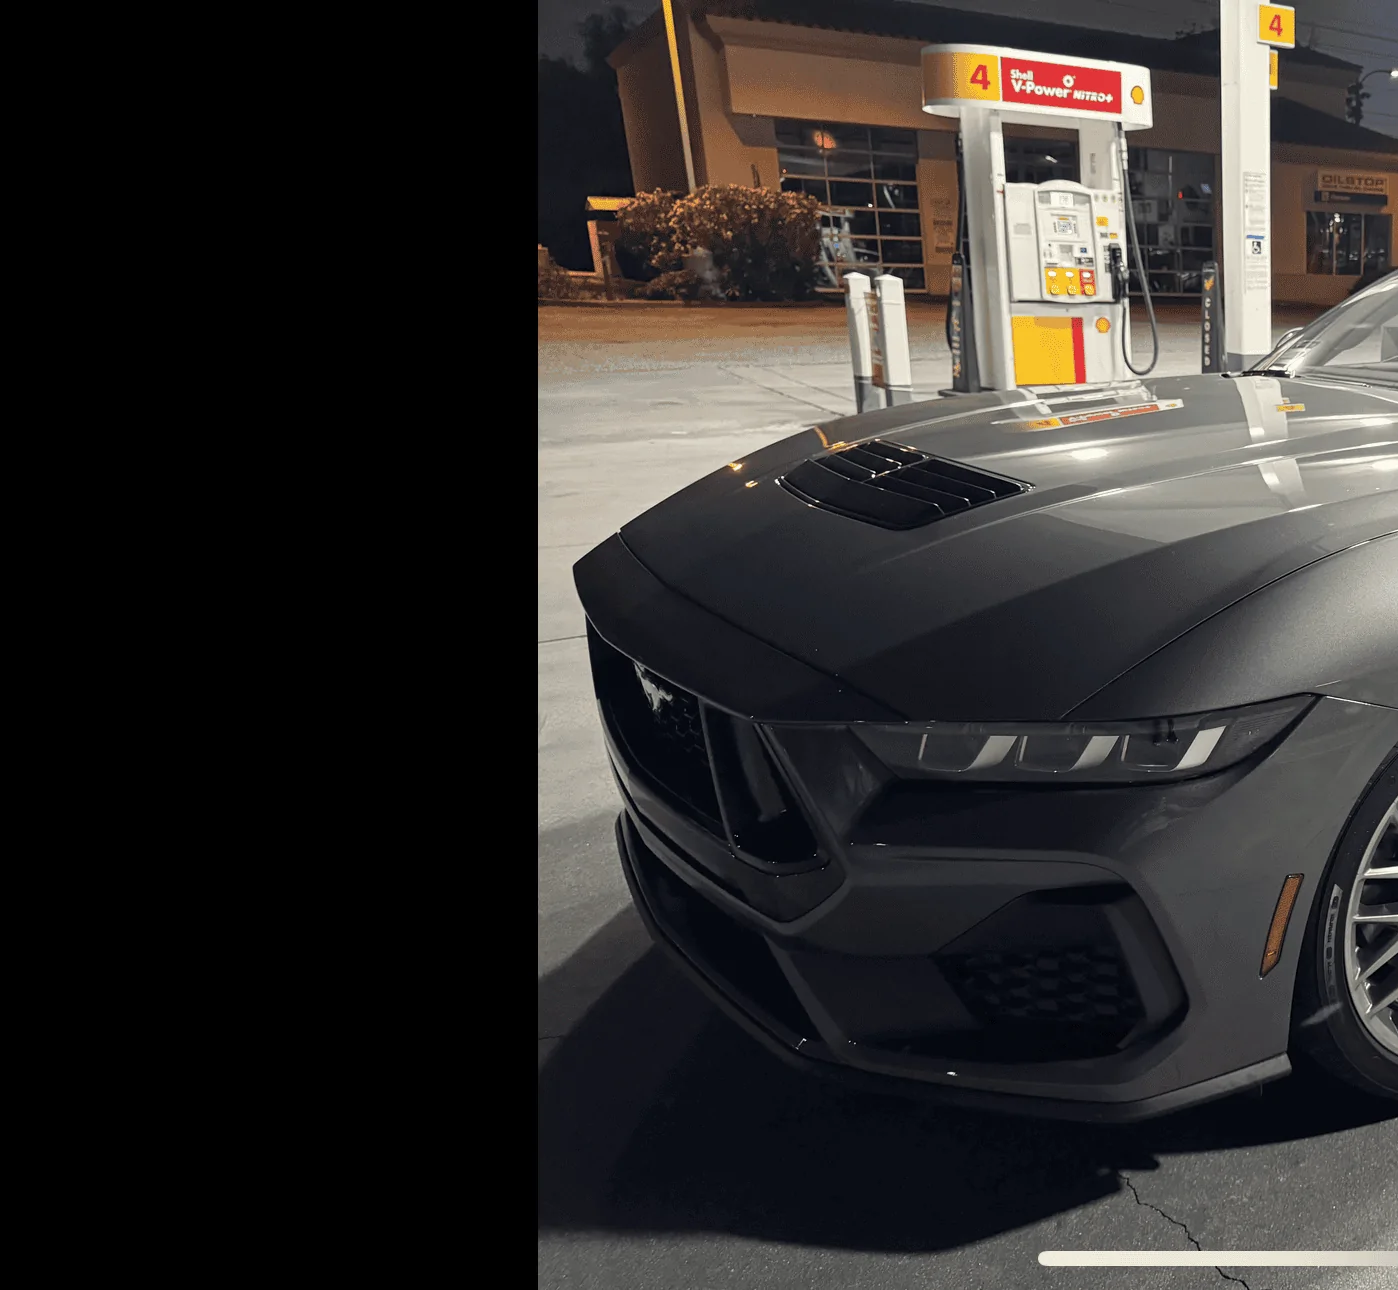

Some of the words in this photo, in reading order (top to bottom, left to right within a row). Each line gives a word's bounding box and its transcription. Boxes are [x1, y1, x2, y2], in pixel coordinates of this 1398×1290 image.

[1269, 14, 1283, 37] 4
[970, 64, 991, 90] 4
[1010, 69, 1034, 81] Shell
[1011, 79, 1069, 98] V-Power
[1321, 174, 1384, 187] OILSTOP
